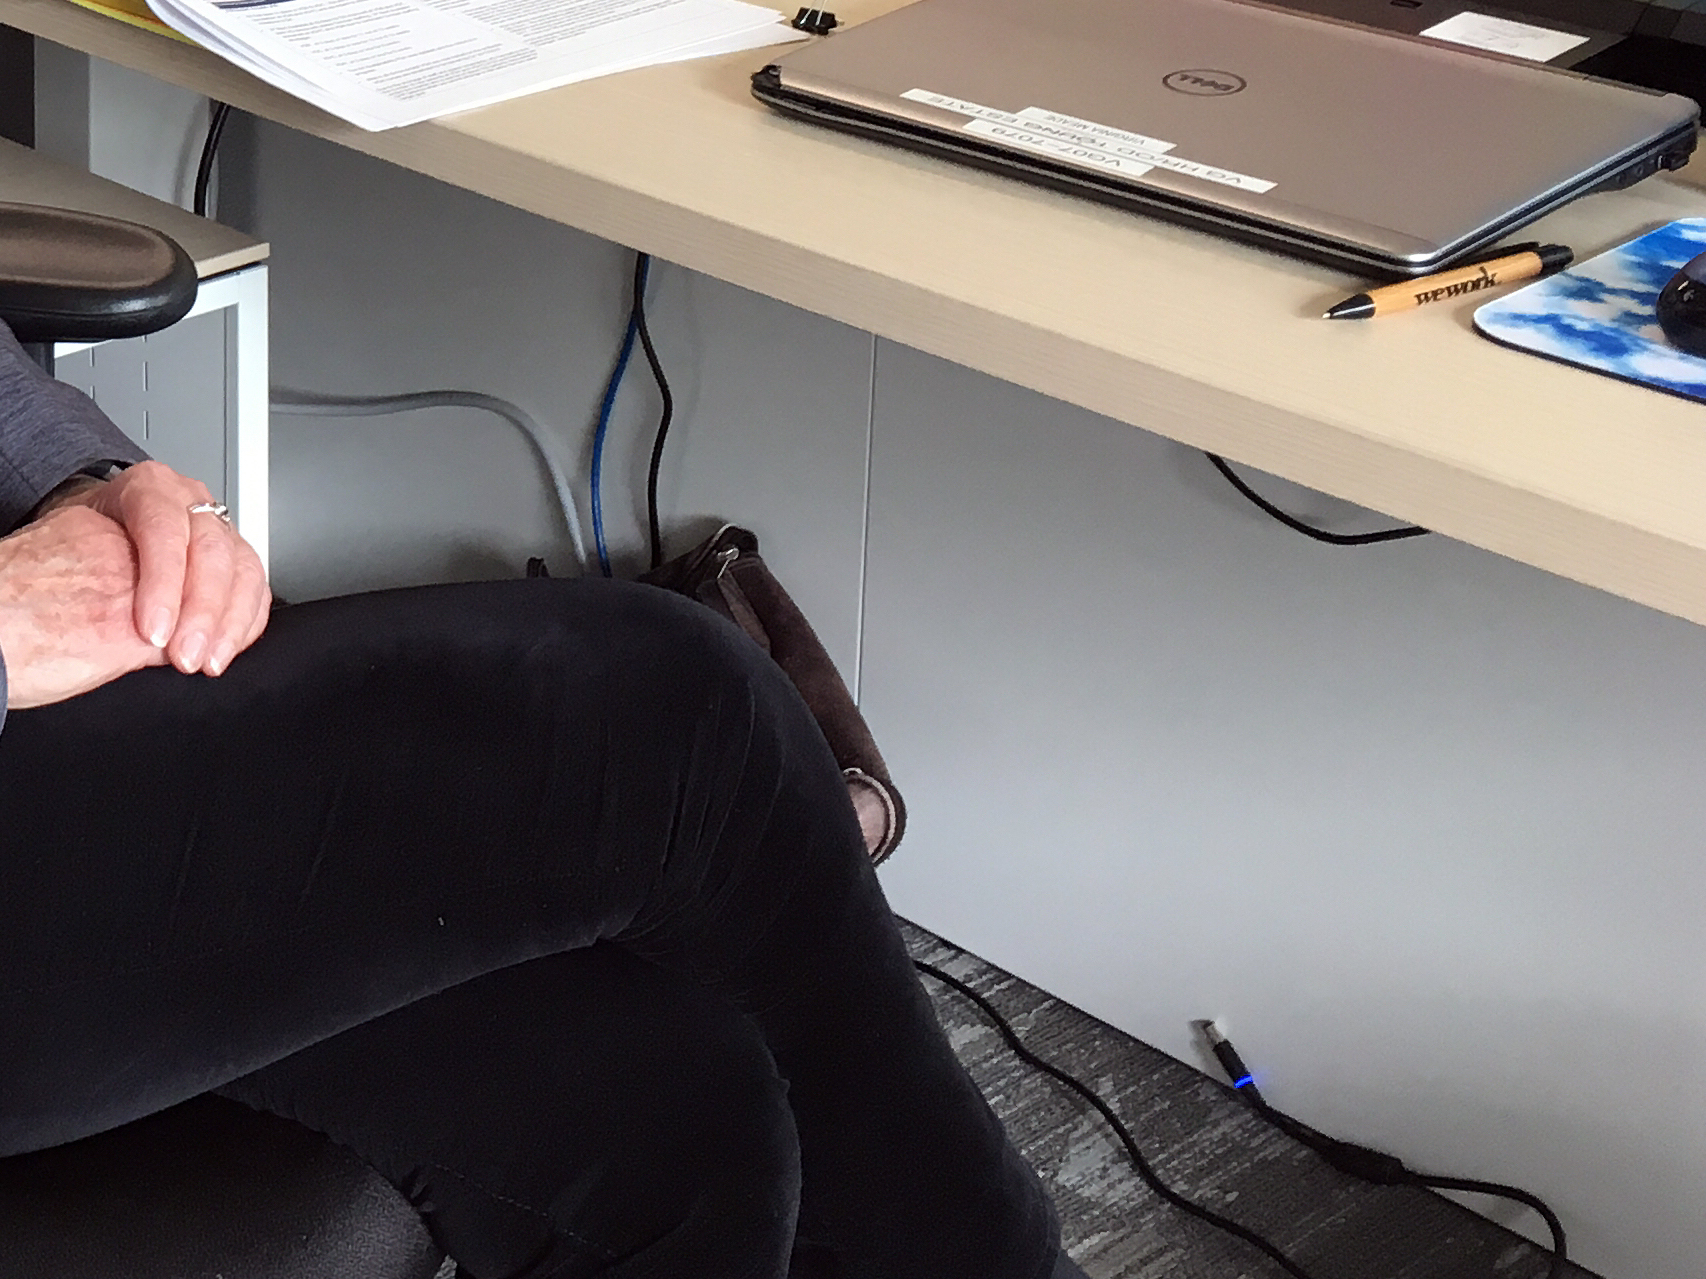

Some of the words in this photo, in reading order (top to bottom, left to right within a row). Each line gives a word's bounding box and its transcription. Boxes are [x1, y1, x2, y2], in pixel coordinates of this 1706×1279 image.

[1179, 74, 1233, 92] DELL
[929, 96, 1018, 124] ESTATE
[1043, 114, 1091, 131] MEADE
[1091, 126, 1146, 146] VIRGINIA
[1205, 170, 1242, 185] VG
[1414, 266, 1498, 307] wework
